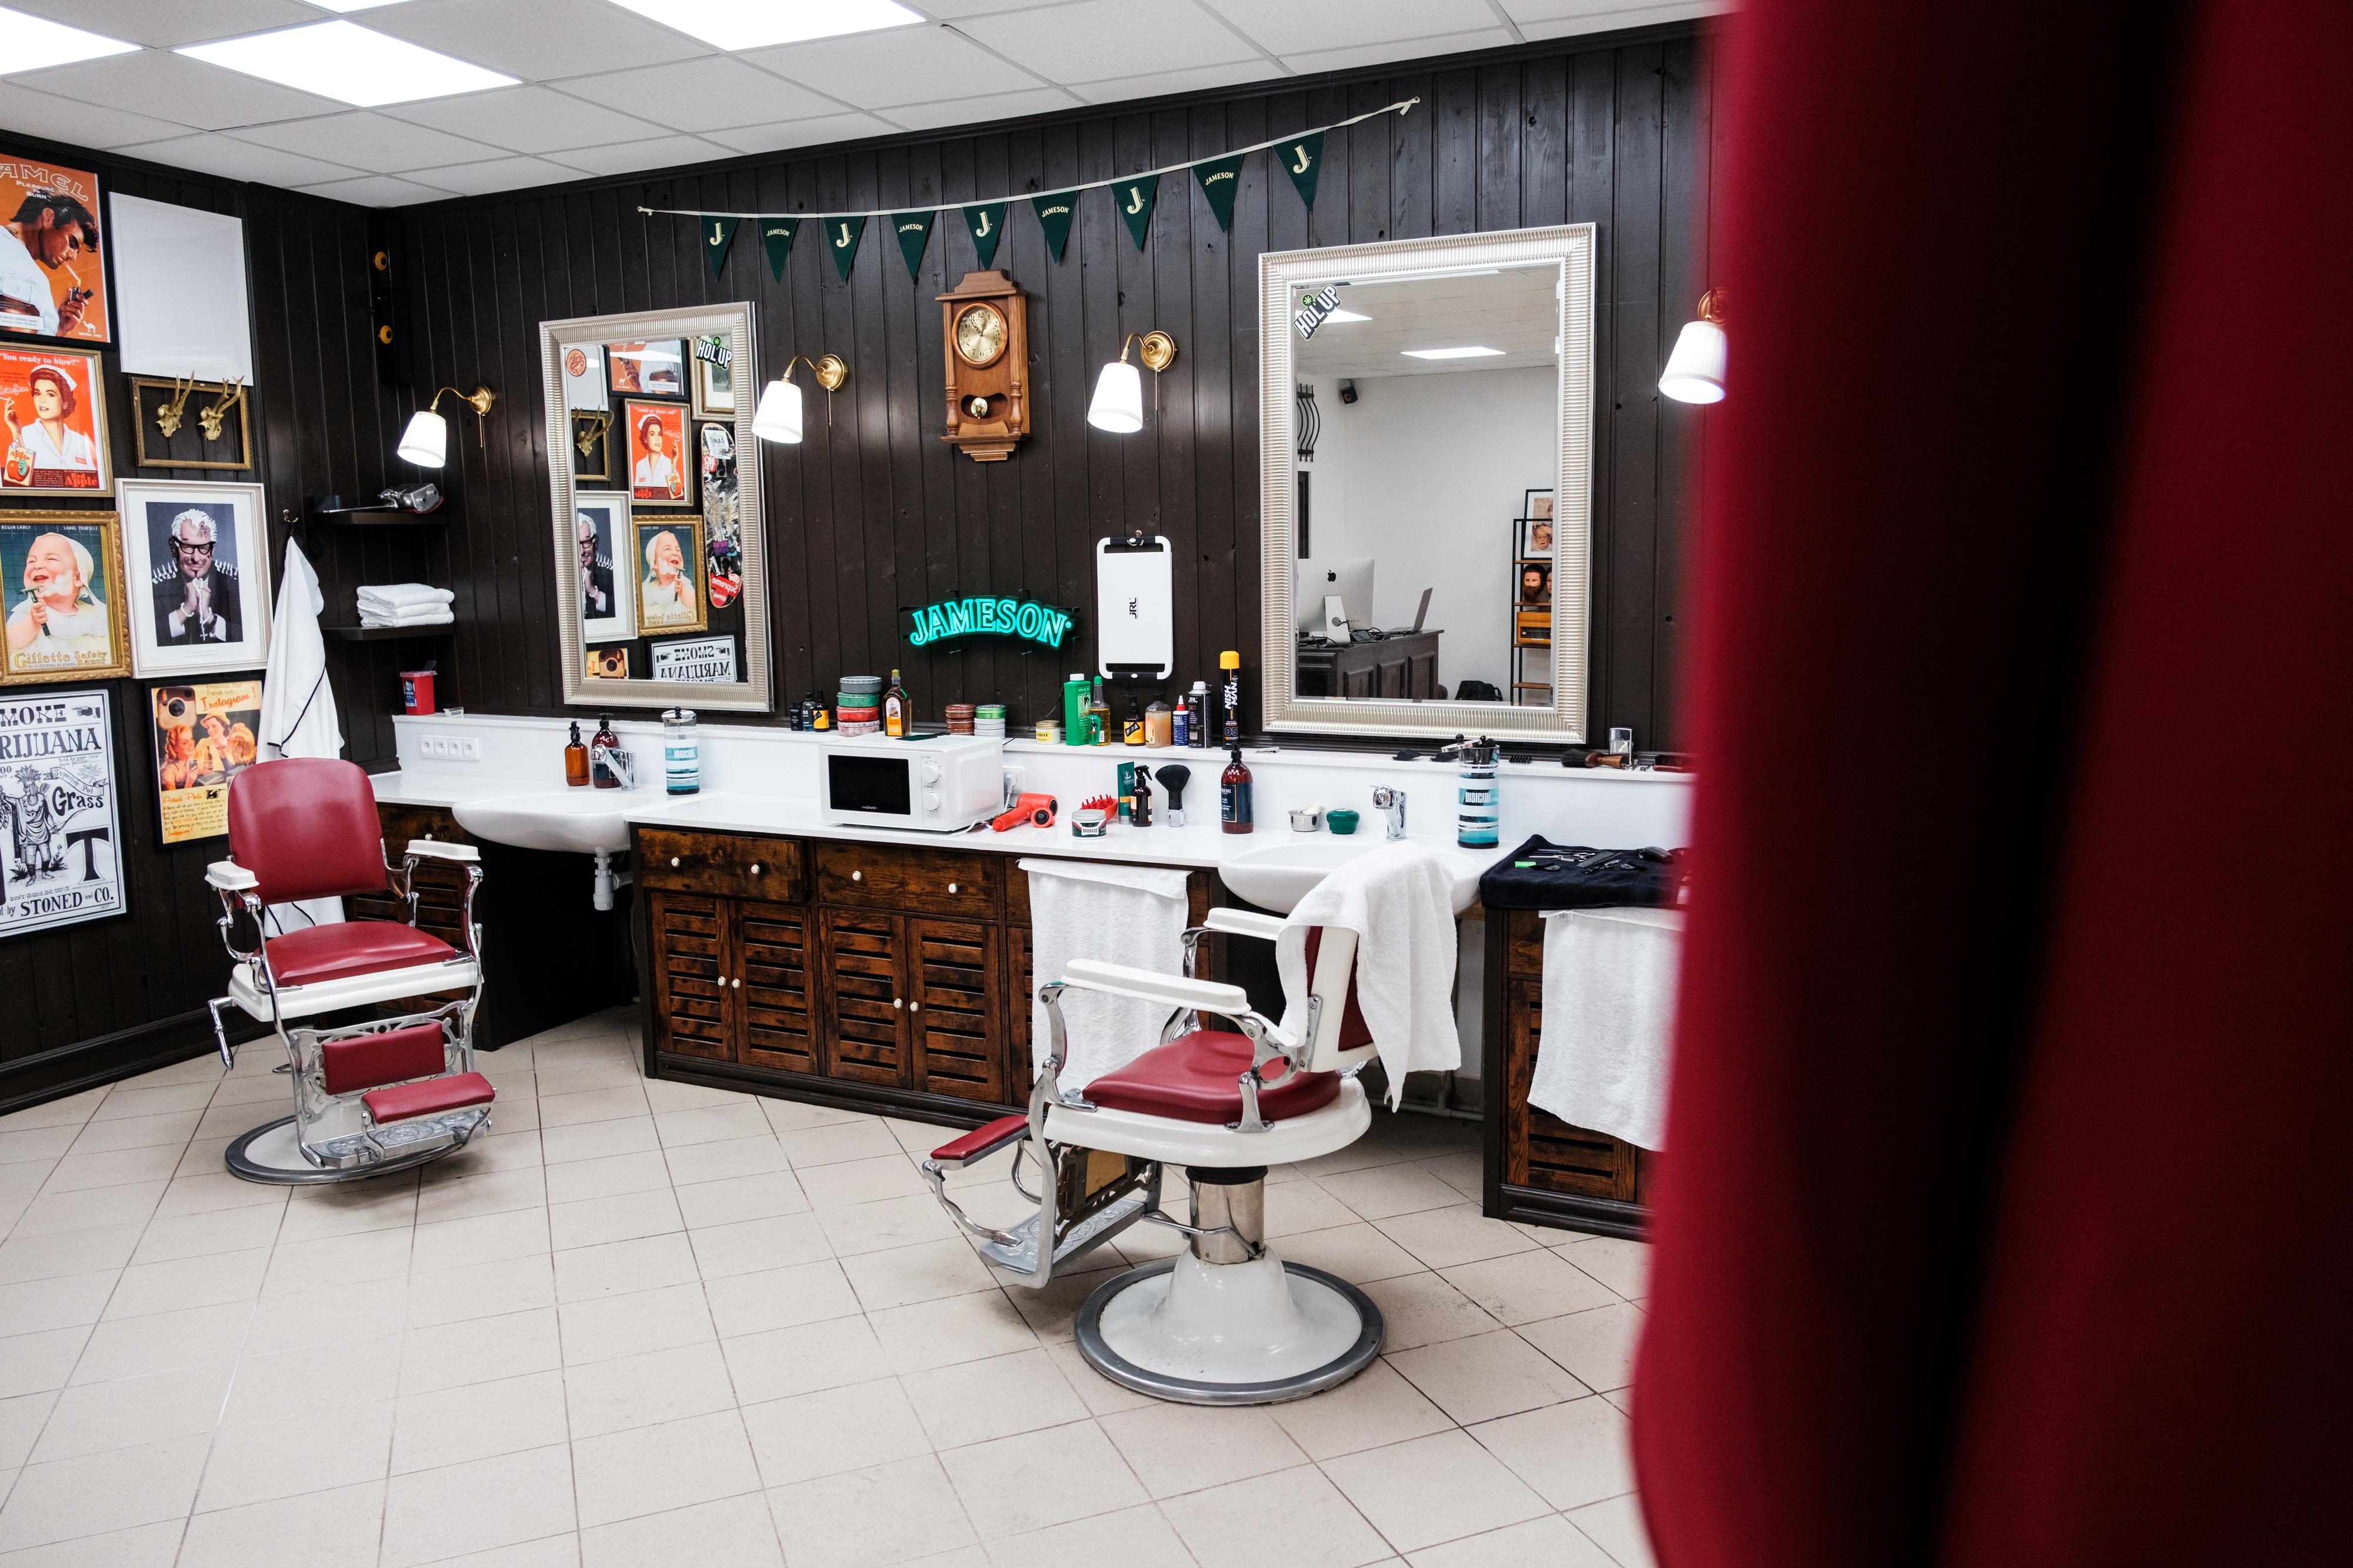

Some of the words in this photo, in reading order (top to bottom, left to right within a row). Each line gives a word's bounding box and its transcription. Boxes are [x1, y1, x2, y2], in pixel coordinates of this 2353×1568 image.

[1293, 145, 1308, 174] J
[0, 164, 88, 202] AMEL
[1205, 171, 1234, 186] JAMESON
[1042, 206, 1069, 218] JAMESON
[1126, 186, 1143, 214] J
[709, 222, 722, 246] J
[836, 223, 851, 248] J
[899, 223, 924, 233] JAMESON
[976, 211, 990, 238] J
[1317, 285, 1340, 311] UP
[19, 355, 41, 364] ready
[718, 347, 732, 368] UP
[65, 475, 97, 488] Apple
[909, 598, 1068, 648] JAMESON
[14, 651, 71, 669] Gillette
[0, 703, 66, 727] MOKE
[200, 695, 250, 712] Instagram
[1224, 726, 1238, 736] 05
[0, 727, 102, 760] RIJUANA
[0, 765, 12, 774] 00
[52, 786, 104, 812] Grass
[21, 892, 82, 916] STONED
[94, 886, 114, 903] CO.
